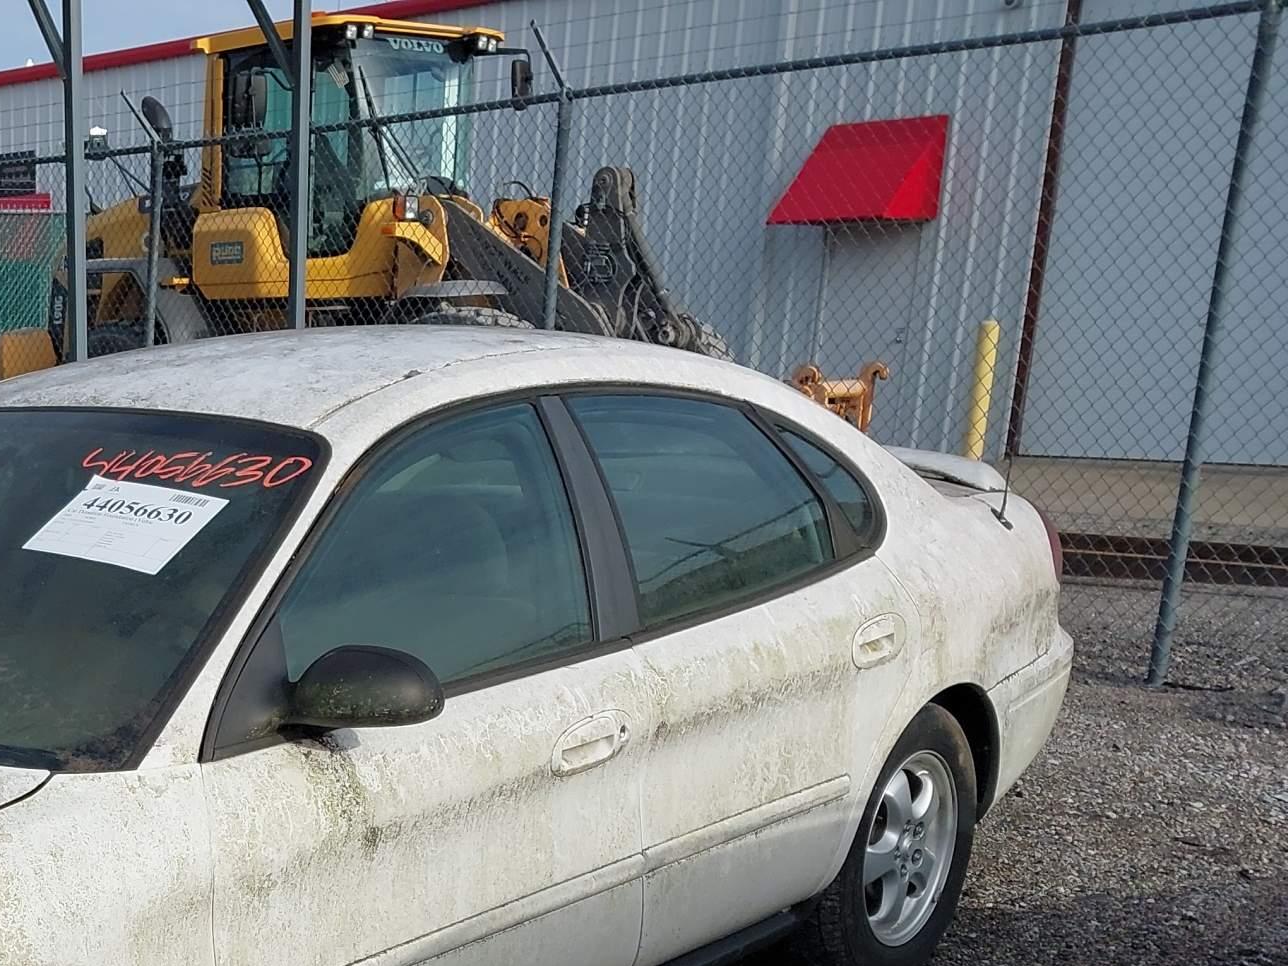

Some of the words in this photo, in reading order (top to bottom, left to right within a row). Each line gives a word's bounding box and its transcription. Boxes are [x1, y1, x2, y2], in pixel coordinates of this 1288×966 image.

[387, 37, 444, 54] VOLVO
[82, 447, 313, 488] 44056630
[82, 496, 193, 525] 44056630
